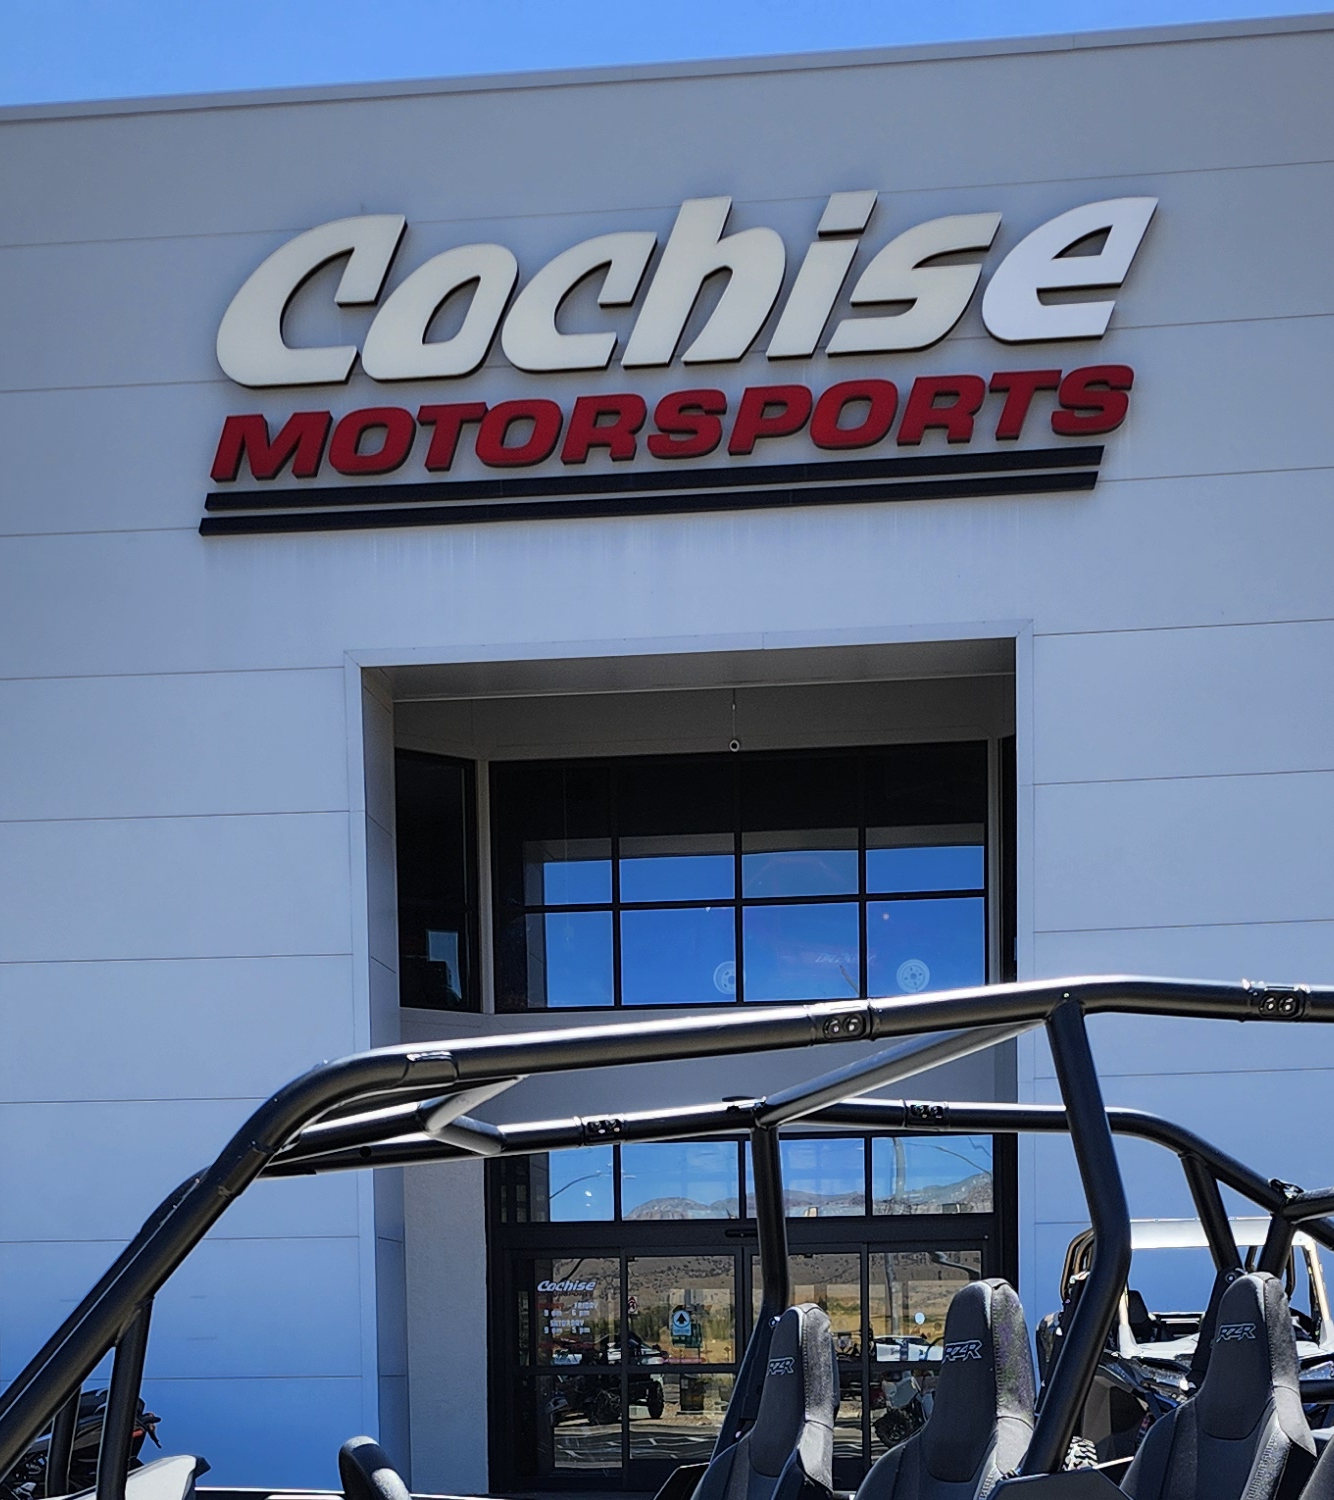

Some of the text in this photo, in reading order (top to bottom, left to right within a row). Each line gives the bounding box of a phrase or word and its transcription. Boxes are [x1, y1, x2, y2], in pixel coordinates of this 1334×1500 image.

[215, 189, 1160, 388] Cochise
[209, 363, 1135, 483] MOTORSPORTS
[537, 1279, 597, 1292] Cochise
[1215, 1322, 1257, 1343] RZR
[942, 1339, 983, 1364] RZR
[768, 1356, 795, 1376] RZR
